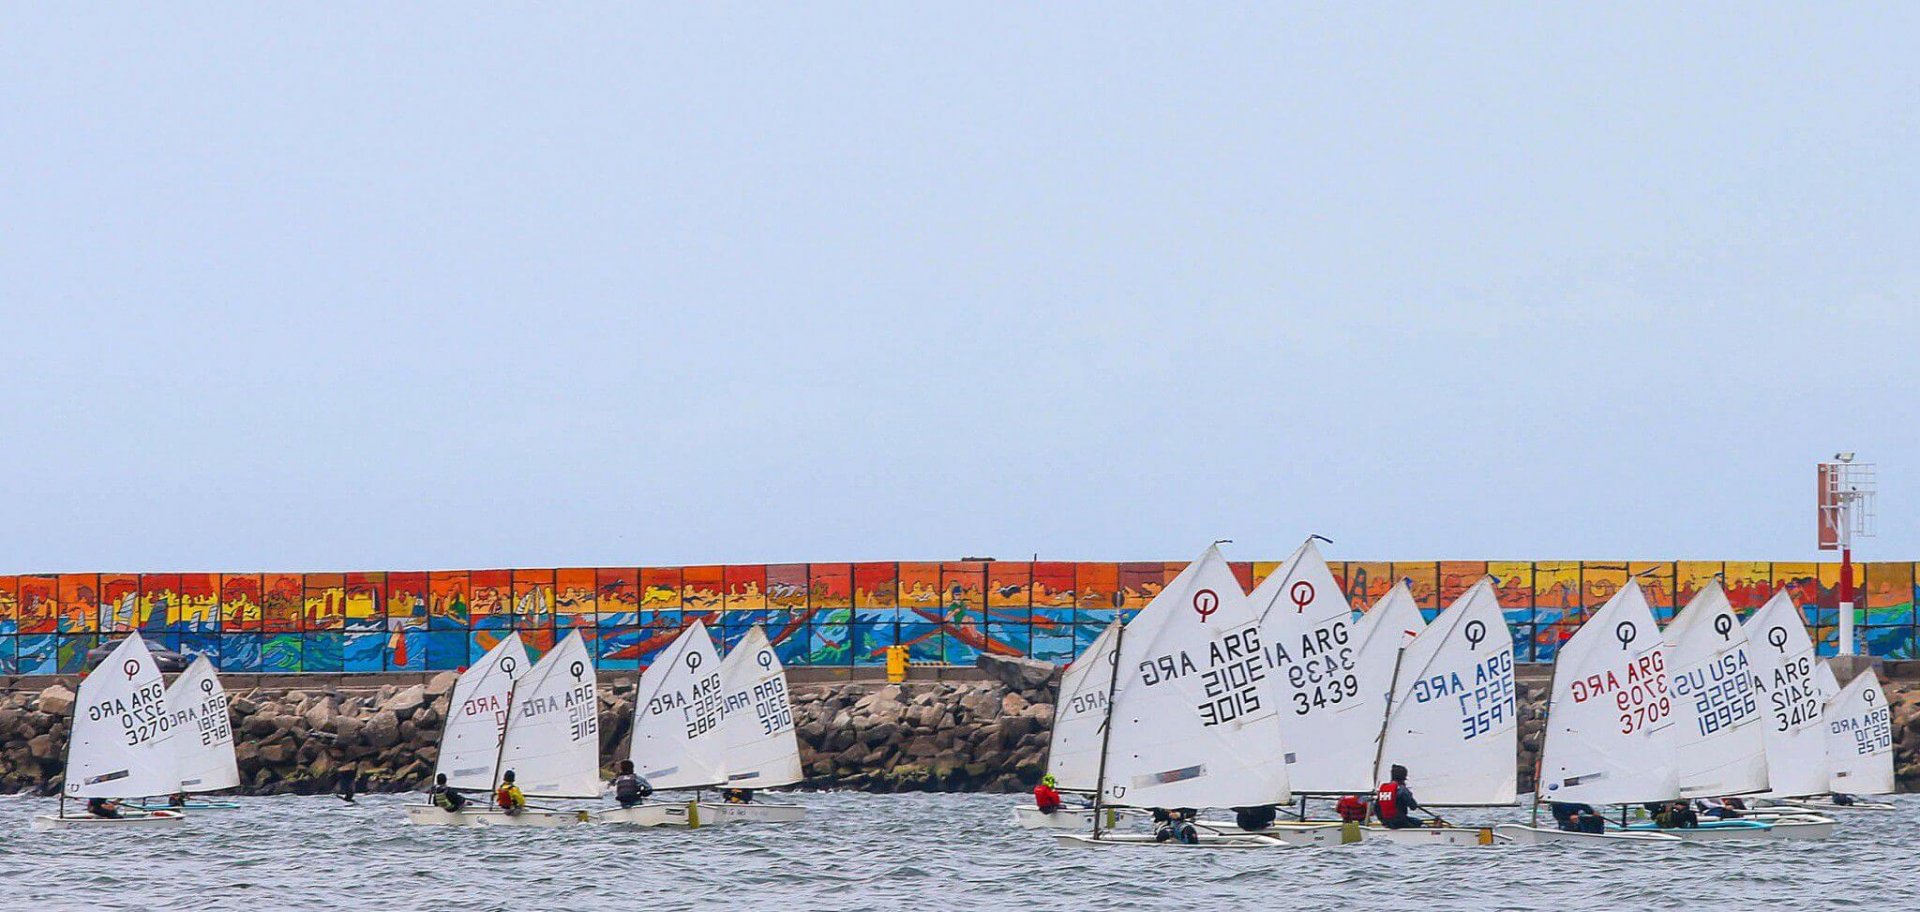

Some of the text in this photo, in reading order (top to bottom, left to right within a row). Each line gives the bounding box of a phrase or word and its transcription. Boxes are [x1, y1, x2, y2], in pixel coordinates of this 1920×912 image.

[1210, 628, 1260, 667] ARG
[1302, 622, 1348, 658] ARG
[1476, 650, 1511, 685] ARG
[1628, 651, 1664, 684] ARG
[1709, 649, 1748, 681] USA
[1775, 657, 1809, 688] ARG
[132, 684, 162, 708] ARG
[565, 684, 593, 708] ARG
[693, 673, 720, 700] ARG
[754, 677, 783, 701] ARG
[1292, 674, 1358, 715] 3439
[202, 696, 225, 715] ARG
[1198, 686, 1260, 727] 3015
[1462, 697, 1514, 740] 3597
[1620, 697, 1670, 734] 3709
[1698, 692, 1756, 736] 18956
[1776, 699, 1818, 731] 3412
[1864, 709, 1888, 726] ARG
[125, 717, 169, 746] 3270
[201, 723, 230, 745] 2781
[571, 717, 596, 741] 3115
[686, 706, 724, 739] 2867
[761, 709, 791, 735] 3310
[1857, 734, 1890, 754] 2570
